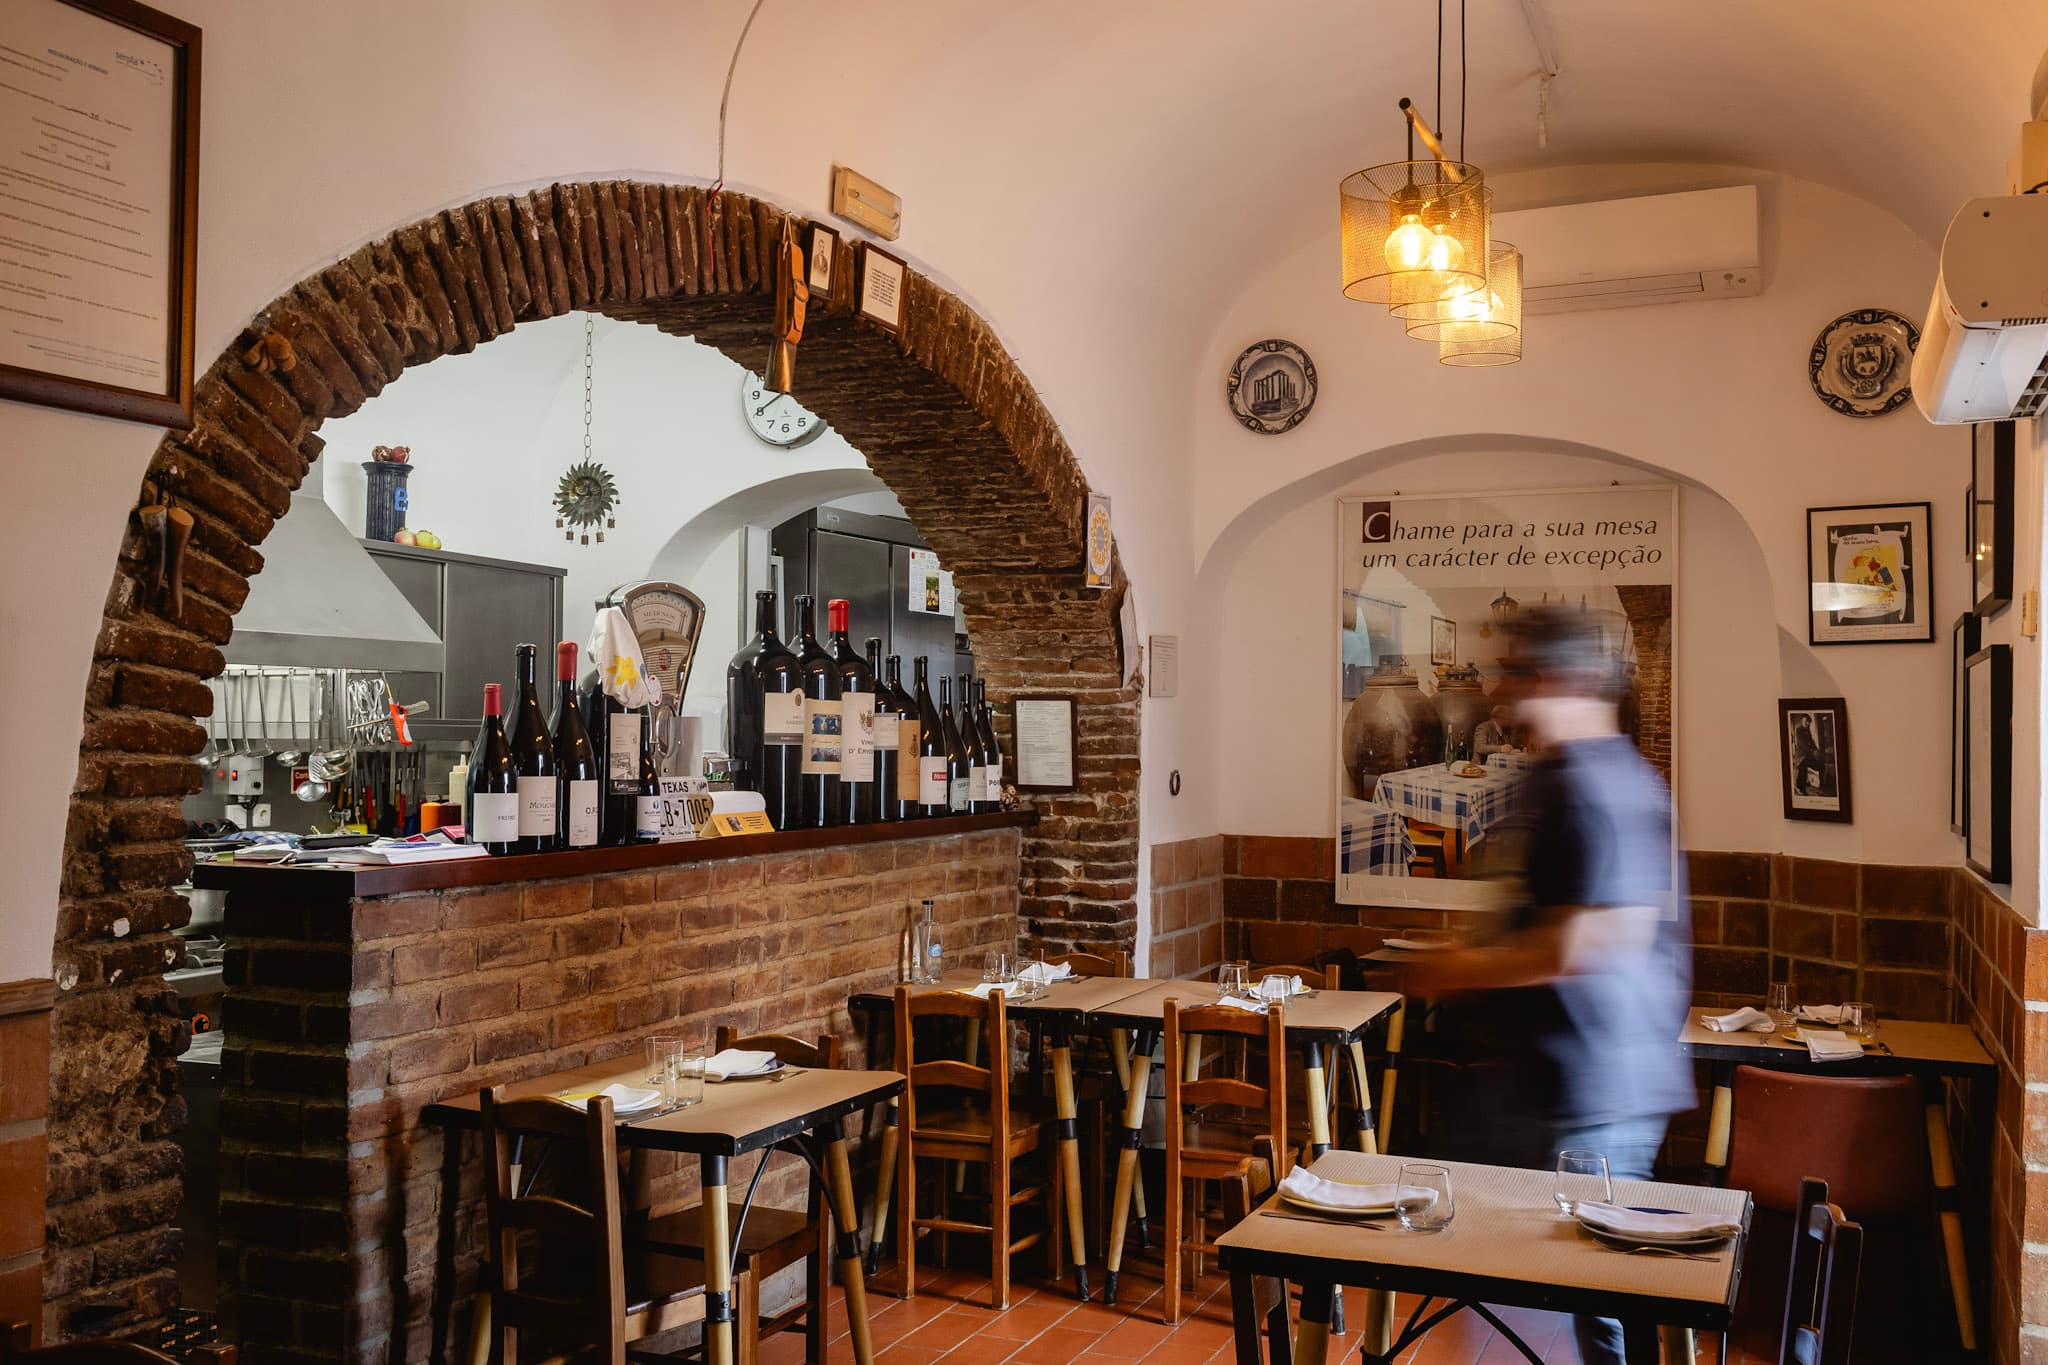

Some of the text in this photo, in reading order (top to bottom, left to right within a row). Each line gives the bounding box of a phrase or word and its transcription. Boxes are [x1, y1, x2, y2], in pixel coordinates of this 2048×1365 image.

[752, 390, 760, 400] 9
[756, 406, 765, 417] 8
[767, 420, 775, 429] 7
[798, 418, 806, 427] 5
[781, 423, 790, 433] 6
[1363, 511, 1658, 545] Chame para a sua mesa
[1362, 544, 1663, 571] um carácter de excepção
[662, 781, 689, 794] TEXAS
